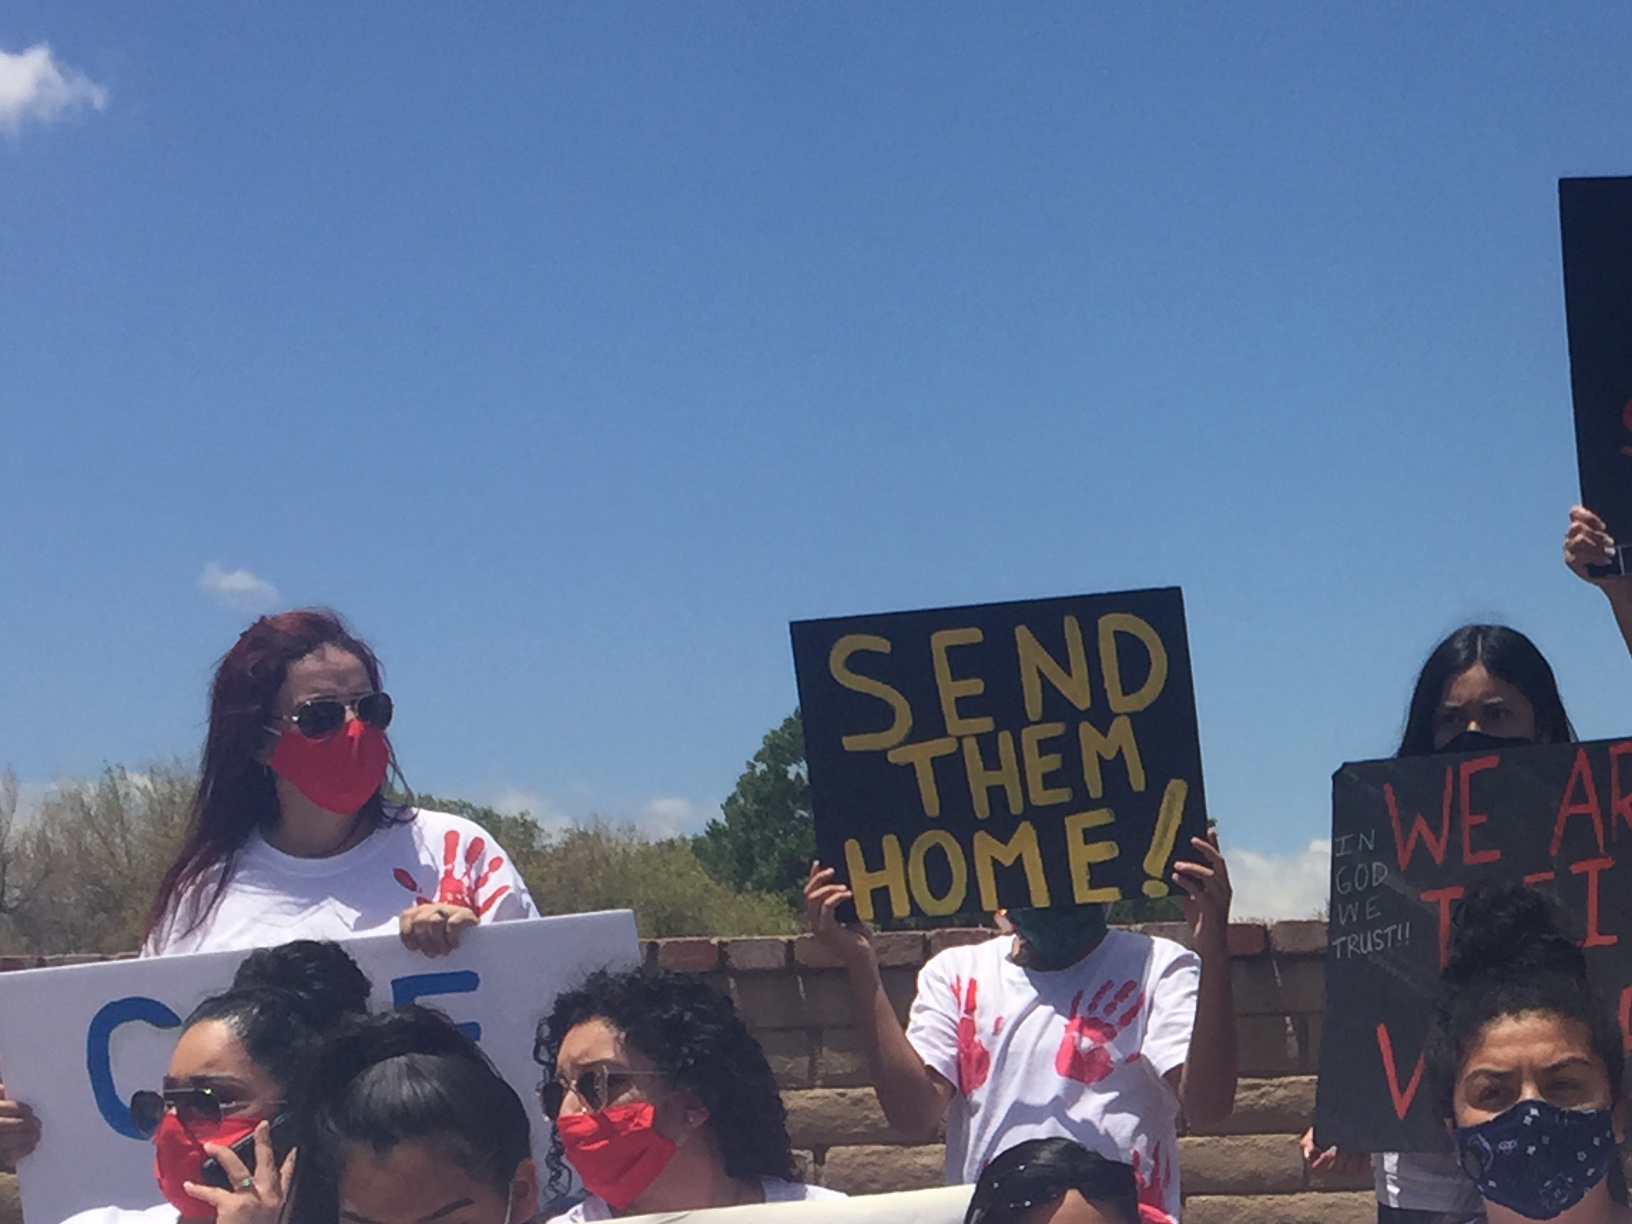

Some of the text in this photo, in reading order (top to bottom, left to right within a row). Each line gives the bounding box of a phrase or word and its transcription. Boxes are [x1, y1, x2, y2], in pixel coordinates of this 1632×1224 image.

[829, 613, 1168, 751] SEND
[887, 715, 1146, 819] THEM
[1335, 829, 1375, 857] IN
[1383, 756, 1500, 871] WE
[844, 779, 1189, 921] HOME!
[1336, 862, 1388, 894] GOD
[1332, 921, 1410, 959] TRUST!!
[1338, 894, 1382, 926] WE
